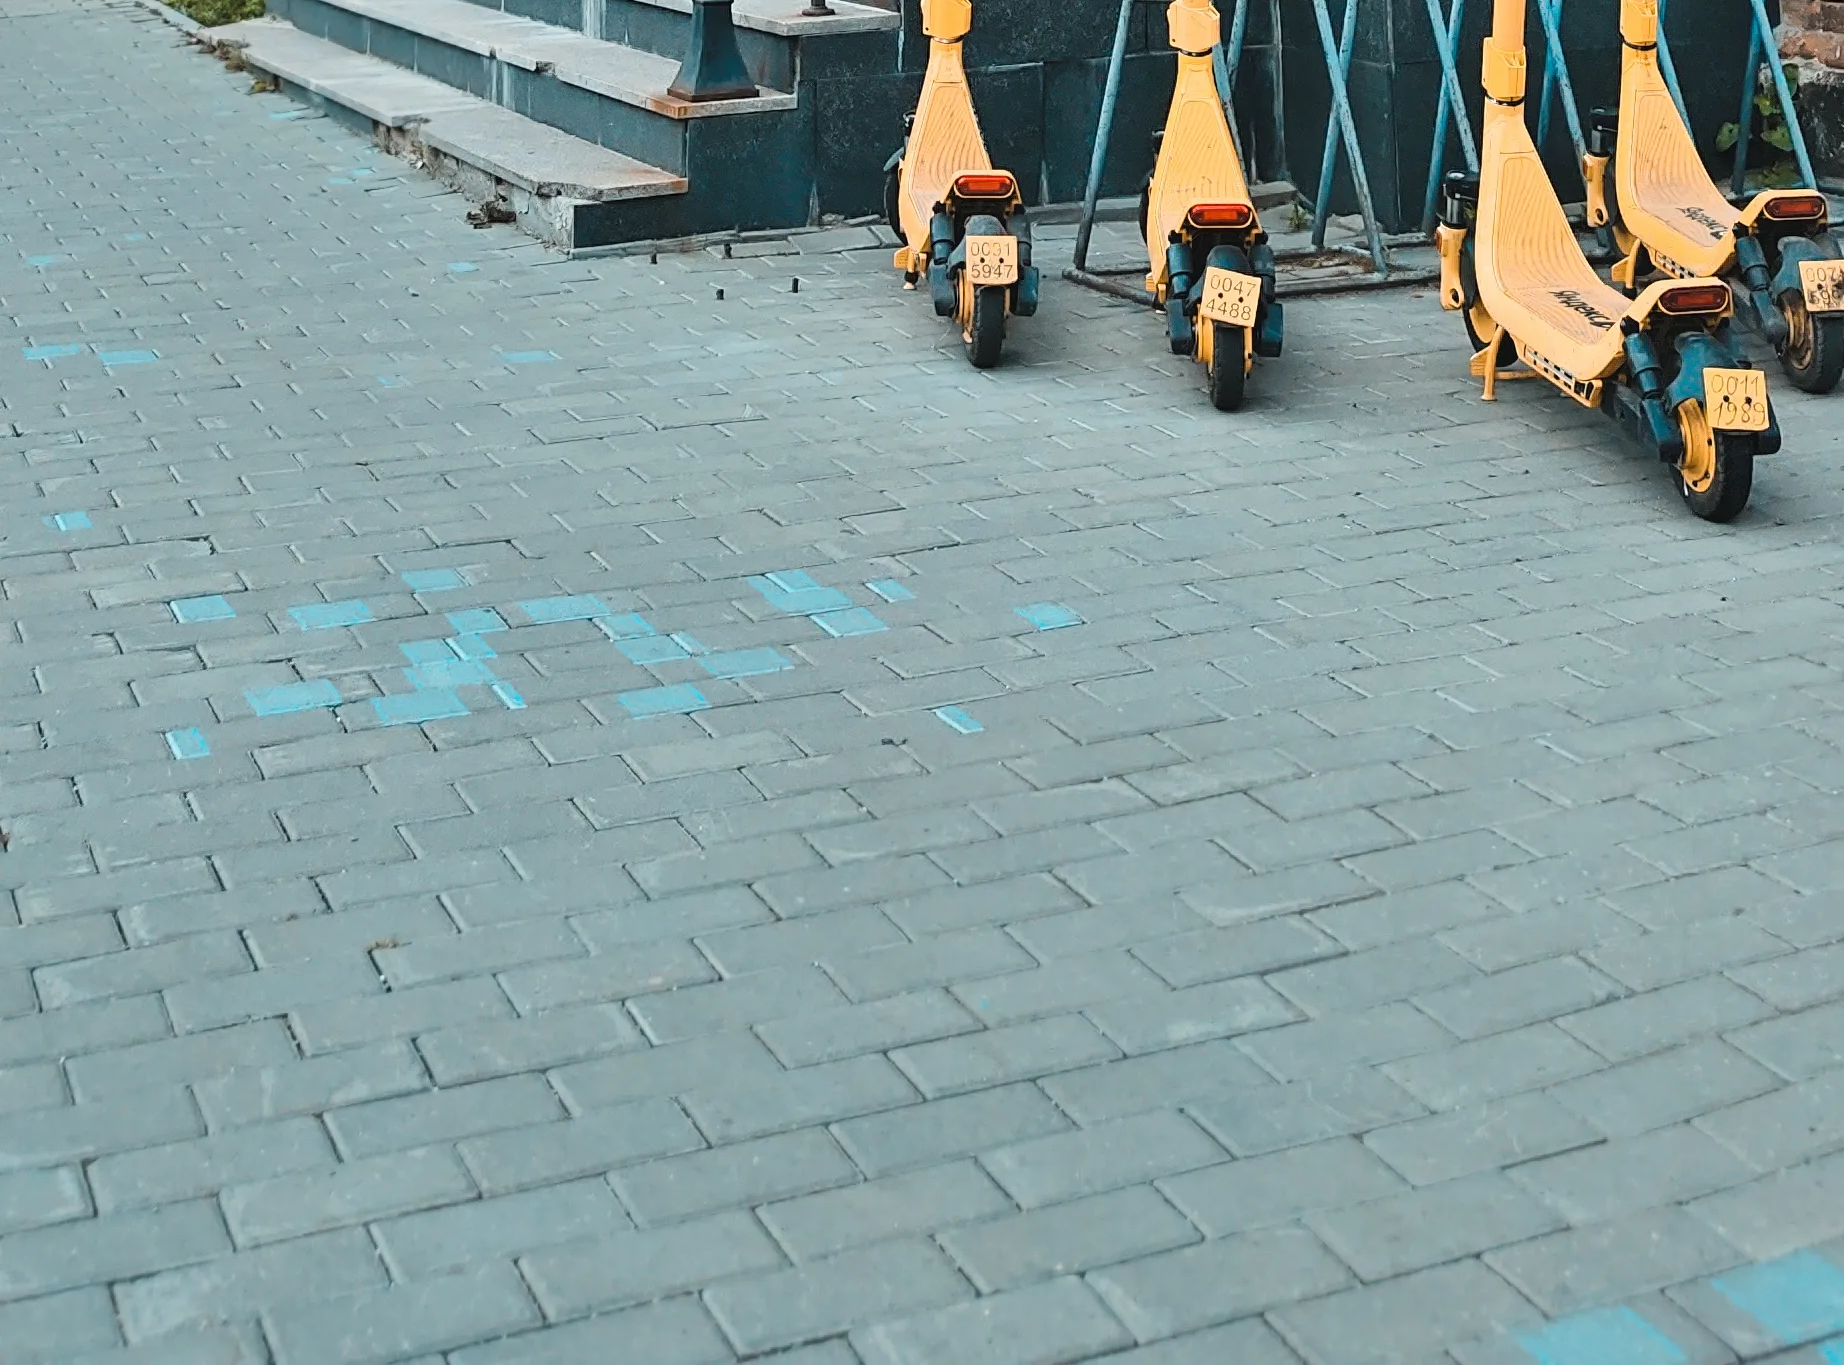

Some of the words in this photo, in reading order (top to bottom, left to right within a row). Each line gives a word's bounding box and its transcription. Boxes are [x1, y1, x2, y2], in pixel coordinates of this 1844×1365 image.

[970, 264, 1014, 279] 5947
[1210, 274, 1257, 297] 0047
[1205, 298, 1252, 320] 4488
[1548, 290, 1611, 321] Яндекс
[1711, 374, 1759, 397] 0011
[1713, 401, 1766, 427] 1989
